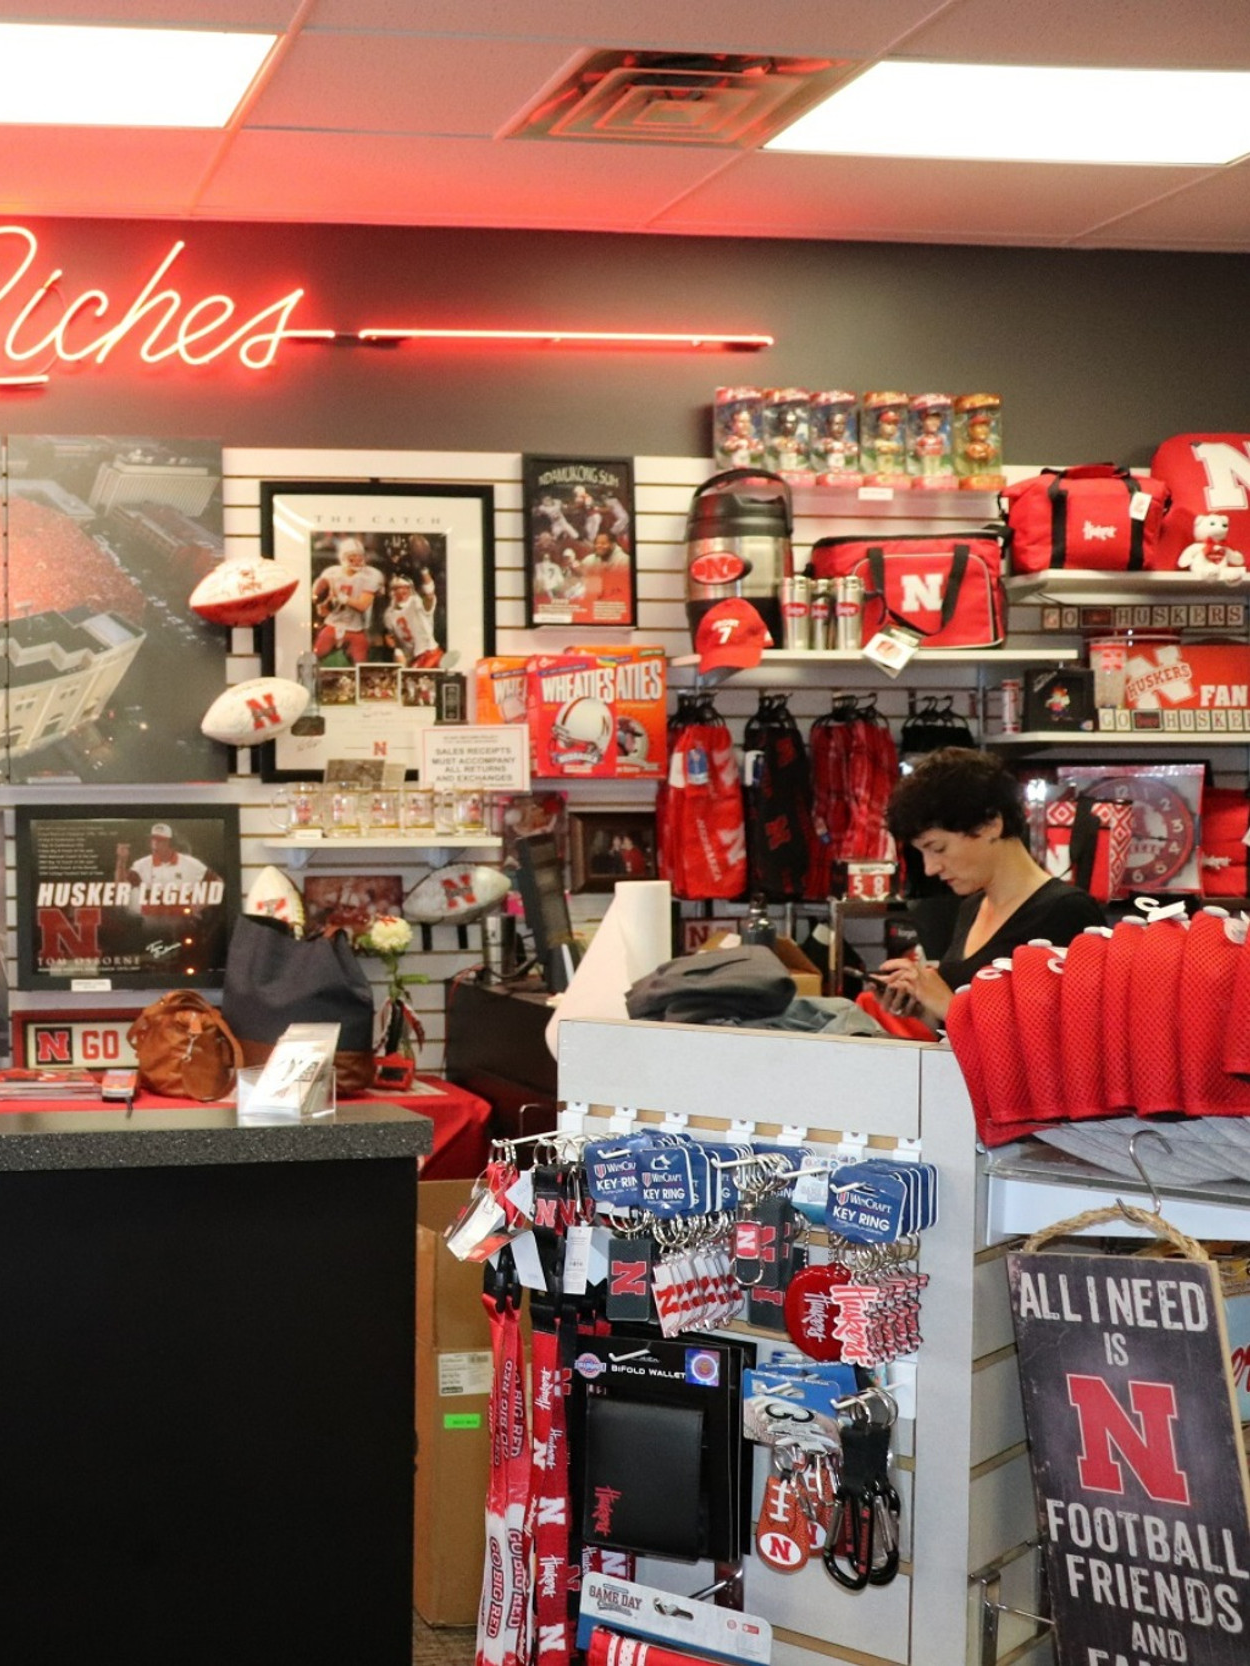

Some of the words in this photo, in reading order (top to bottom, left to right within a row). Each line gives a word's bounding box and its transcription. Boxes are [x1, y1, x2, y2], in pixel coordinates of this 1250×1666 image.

[315, 515, 356, 524] THE
[372, 515, 441, 525] CATCH
[901, 573, 943, 612] N
[1117, 605, 1242, 625] HUSKERS
[717, 627, 733, 645] 7
[541, 668, 615, 704] WHEATIES
[617, 659, 663, 700] ATIES
[1127, 663, 1192, 698] HUSKERS
[1200, 684, 1249, 707] FAN
[245, 693, 282, 730] N
[1165, 709, 1250, 728] HUSKE
[373, 741, 387, 756] N
[459, 757, 515, 765] ACCOMPANY
[467, 747, 512, 755] RECEIPTS
[1171, 819, 1184, 832] 3
[1169, 842, 1181, 855] 4
[441, 874, 477, 911] N
[1133, 870, 1145, 883] 6
[36, 881, 132, 907] HUSKER
[138, 880, 225, 906] LEGEND
[36, 907, 102, 960] N
[689, 925, 710, 946] N
[37, 956, 68, 966] TOM
[74, 956, 141, 966] OSBORNE
[37, 1030, 70, 1061] N
[81, 1029, 120, 1060] GO
[596, 1177, 617, 1191] KEY
[643, 1188, 661, 1200] KEY
[662, 1187, 685, 1200] RING
[535, 1198, 557, 1228] N
[832, 1204, 857, 1220] KEY
[858, 1214, 890, 1232] RING
[736, 1230, 757, 1249] N
[611, 1260, 647, 1296] N
[655, 1284, 681, 1318] N
[802, 1291, 831, 1343] Huskers
[1019, 1271, 1083, 1323] ALL
[1086, 1275, 1101, 1324] I
[1106, 1276, 1210, 1333] NEED
[830, 1281, 879, 1367] Huskers
[1103, 1331, 1130, 1367] IS
[501, 1359, 513, 1394] RED
[648, 1368, 686, 1380] WALLET
[511, 1423, 524, 1458] RED
[1066, 1373, 1191, 1507] N
[537, 1496, 566, 1527] N
[591, 1484, 622, 1537] Huskers
[489, 1536, 503, 1567] GO
[769, 1536, 791, 1563] N
[1046, 1498, 1250, 1580] FOOTBALL
[491, 1567, 504, 1605] BIG
[538, 1554, 565, 1598] Huskers
[589, 1585, 619, 1604] GAME
[621, 1594, 643, 1610] DAY
[1065, 1553, 1244, 1634] FRIENDS
[486, 1603, 503, 1639] RED
[538, 1623, 567, 1655] N
[1131, 1620, 1188, 1663] AND
